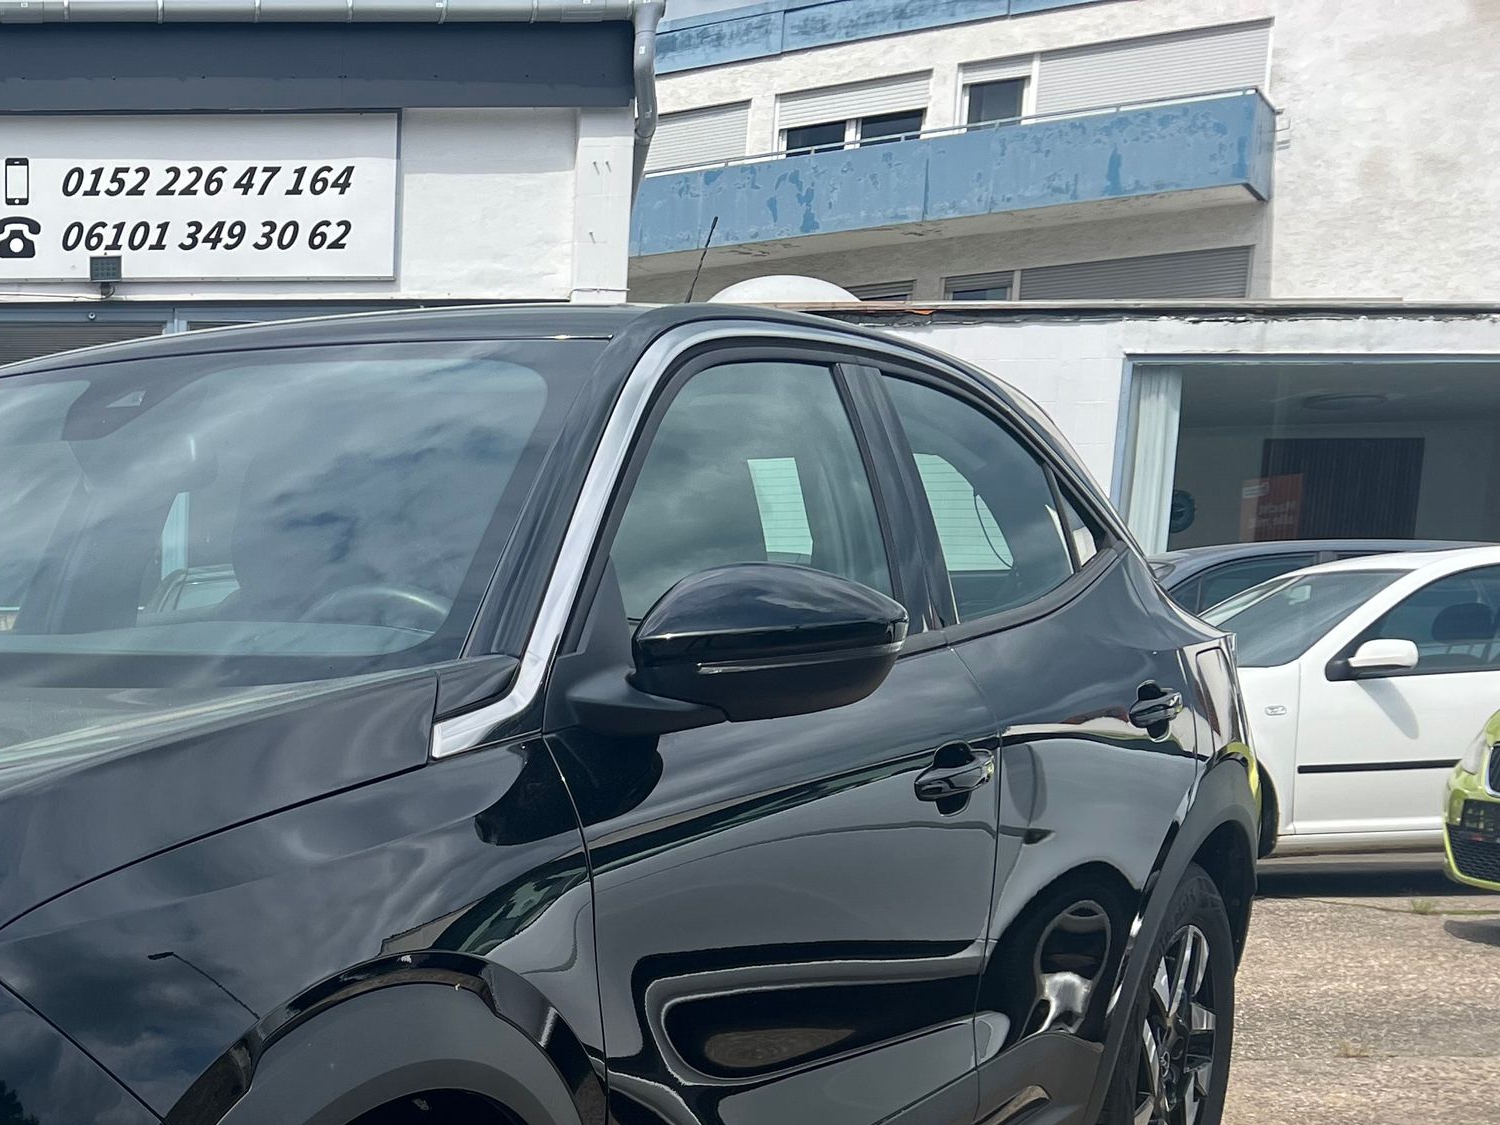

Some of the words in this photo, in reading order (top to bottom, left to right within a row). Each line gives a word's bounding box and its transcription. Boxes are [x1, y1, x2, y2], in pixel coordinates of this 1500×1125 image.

[62, 166, 151, 197] 0152
[155, 165, 228, 196] 226
[232, 166, 282, 196] 47
[284, 165, 355, 196] 164
[61, 220, 171, 252] 06101
[177, 220, 247, 251] 349
[252, 220, 300, 251] 30
[308, 219, 352, 251] 62
